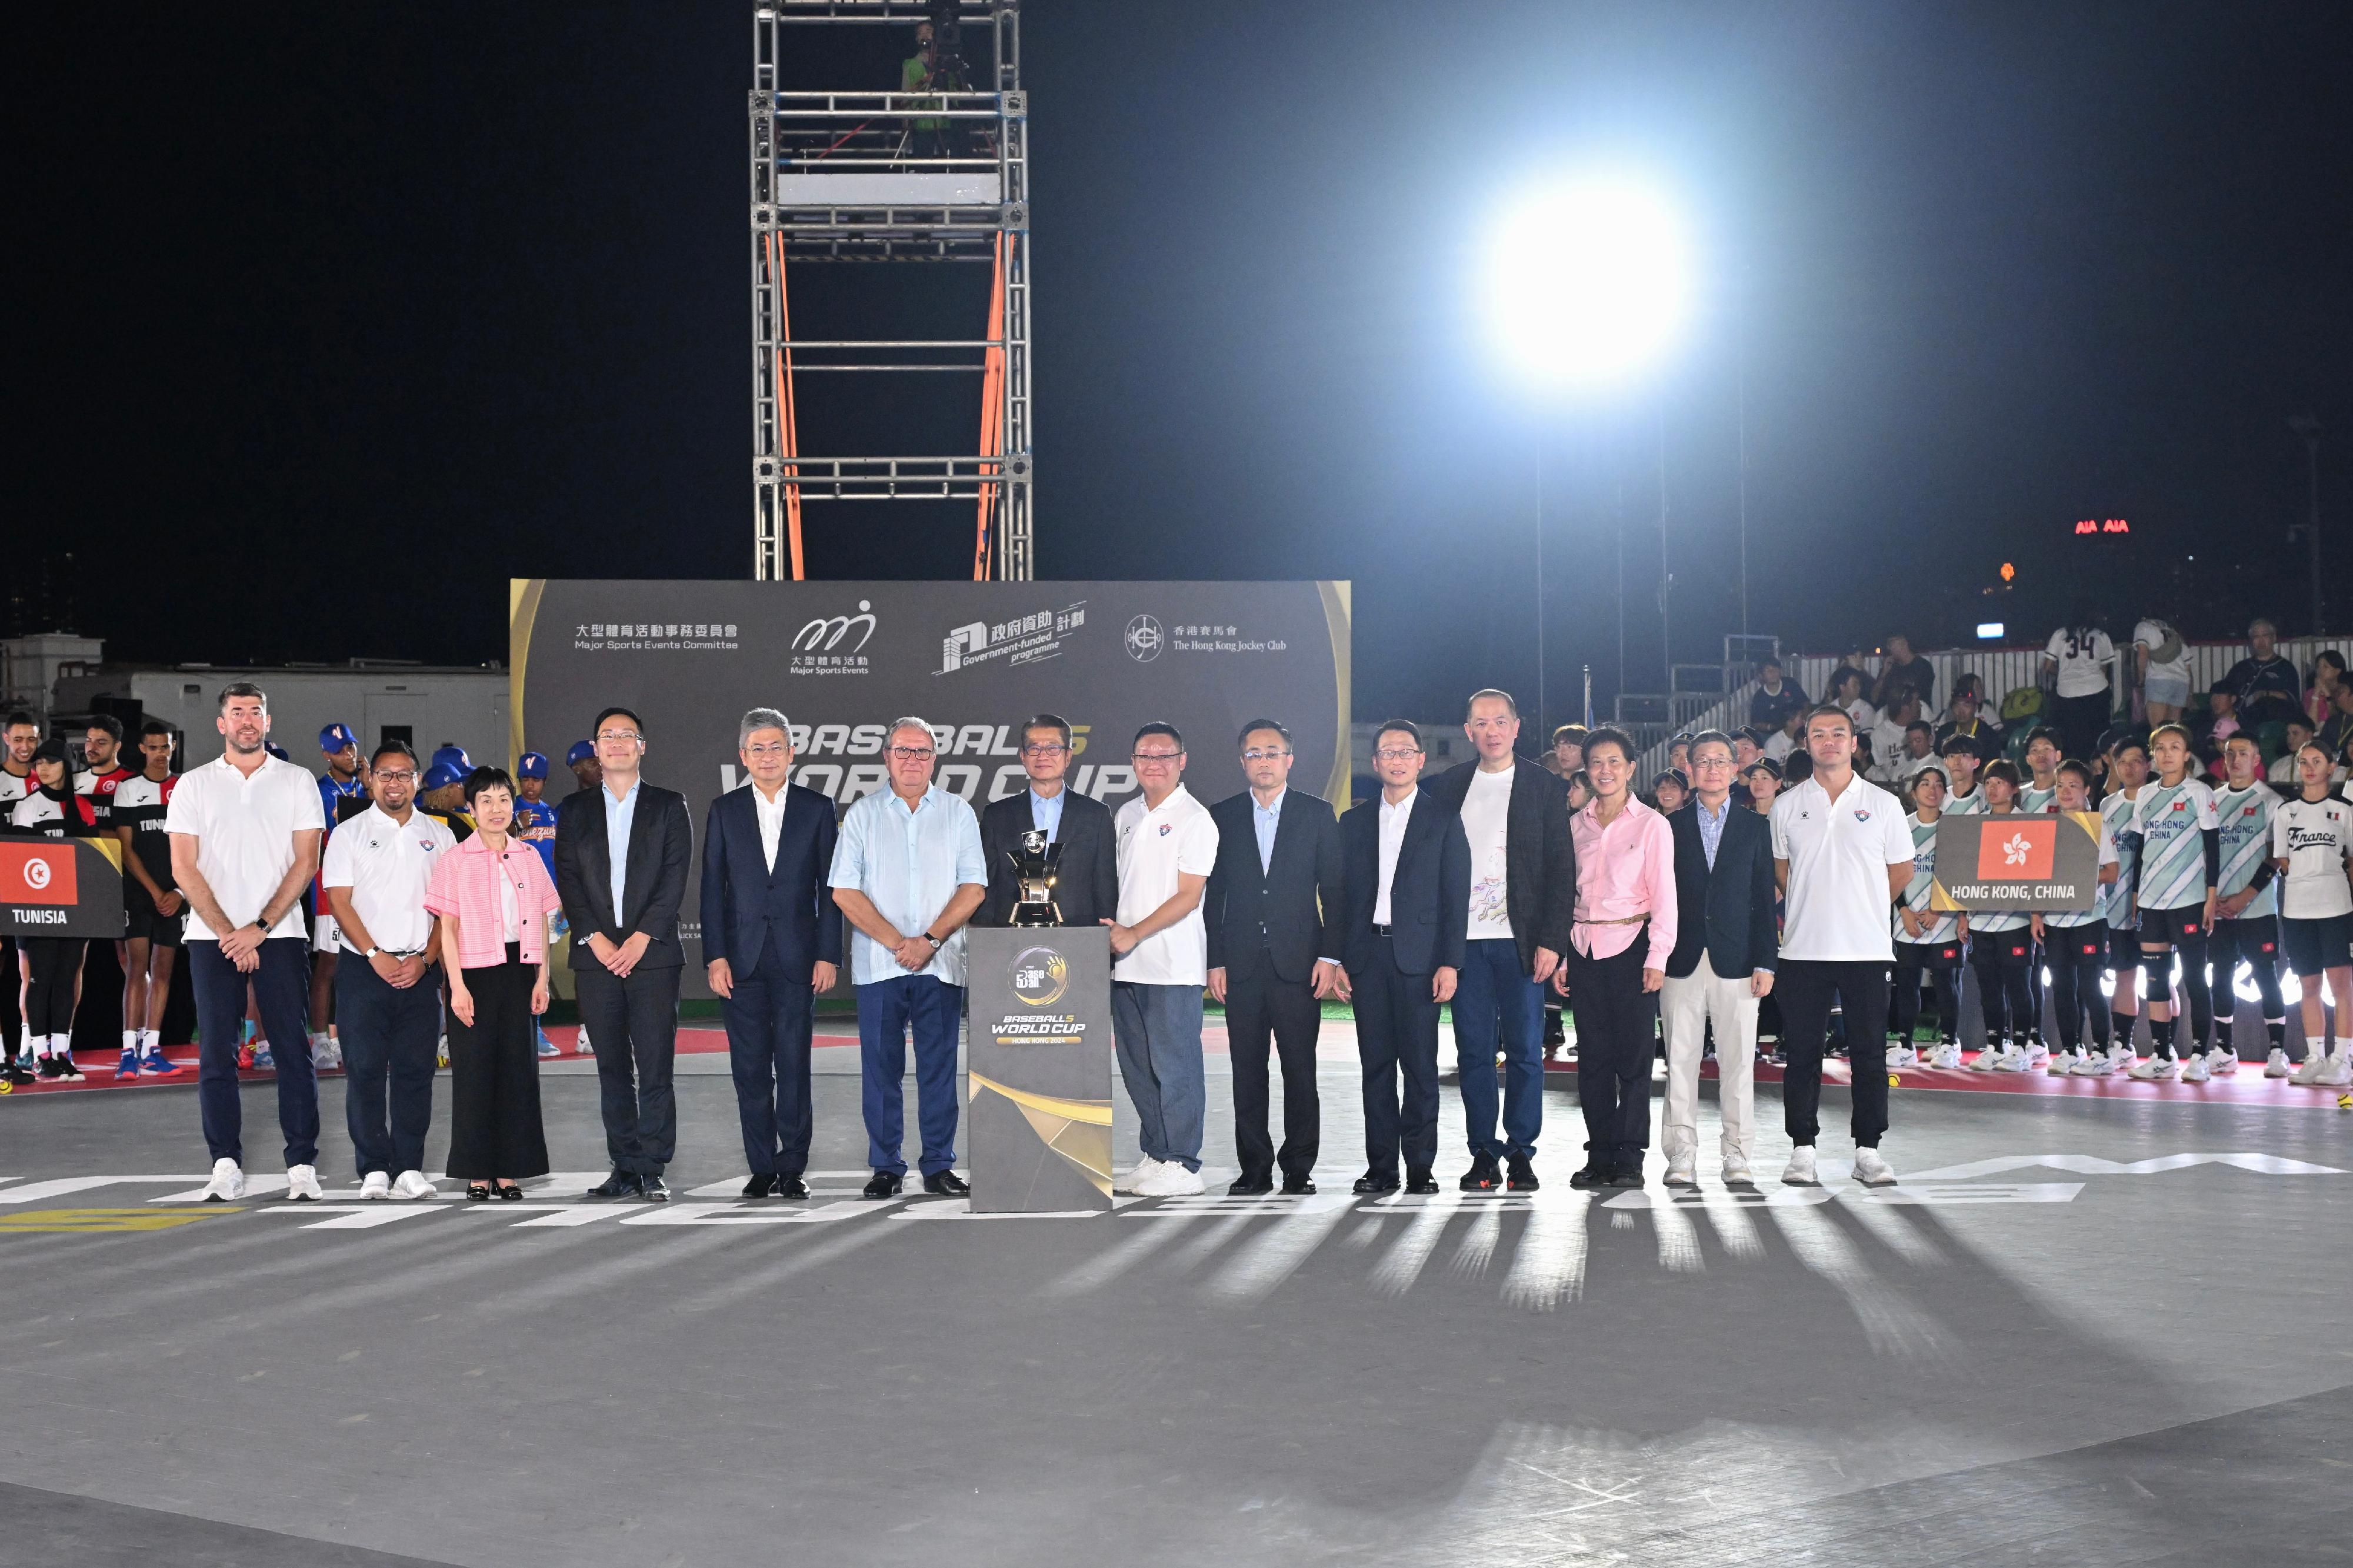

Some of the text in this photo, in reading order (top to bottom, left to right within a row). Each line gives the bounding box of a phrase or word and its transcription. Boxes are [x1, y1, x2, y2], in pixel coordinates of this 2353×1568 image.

[2075, 520, 2098, 534] AIA
[2104, 519, 2129, 533] AIA
[576, 625, 738, 637] 大型體育活動事務委員會
[991, 610, 1052, 643] 政府資助
[1173, 625, 1237, 636] 香港賽馬會
[575, 640, 738, 650] Major Sports Events Committee
[963, 631, 1052, 666] Government-funded
[1174, 640, 1286, 652] The Hong Kong Jockey Club
[2066, 635, 2095, 659] 34
[1011, 642, 1059, 663] programme
[791, 656, 868, 665] 大型體育活動
[791, 667, 814, 675] Major
[816, 667, 841, 675] Sports
[788, 725, 1091, 755] BASBAL5
[721, 764, 982, 804] ORD
[2144, 820, 2185, 830] ONG HONG
[2150, 830, 2171, 839] CHINA
[2288, 827, 2336, 850] France
[1951, 885, 2075, 900] HONG KONG, CHINA
[12, 909, 67, 924] TUNISIA
[1003, 1015, 1075, 1023] BASEBALL5
[992, 1023, 1086, 1034] WORLD CUP
